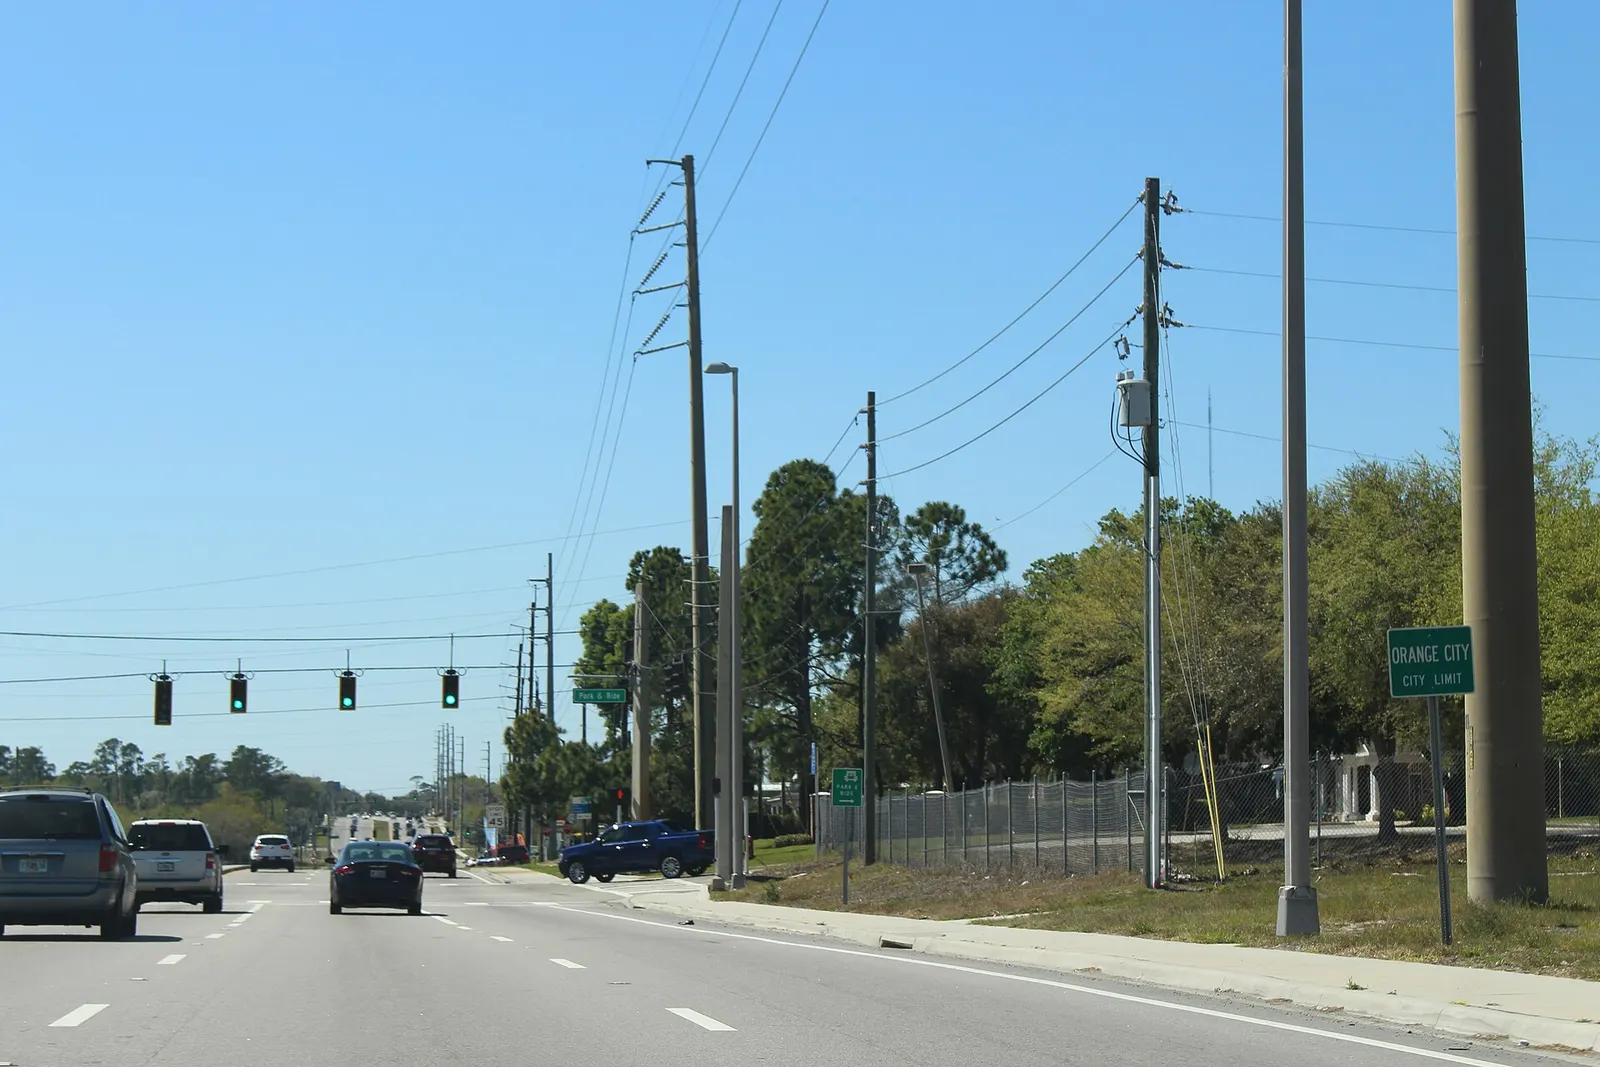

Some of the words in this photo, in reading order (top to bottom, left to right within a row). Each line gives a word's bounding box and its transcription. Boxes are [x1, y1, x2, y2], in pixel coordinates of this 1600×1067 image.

[1392, 646, 1439, 664] ORANGE
[1444, 644, 1469, 661] CITY
[1403, 675, 1425, 686] CITY
[1435, 673, 1461, 685] LIMIT
[579, 692, 594, 700] Park
[606, 692, 620, 700] Ride
[489, 817, 503, 825] 45
